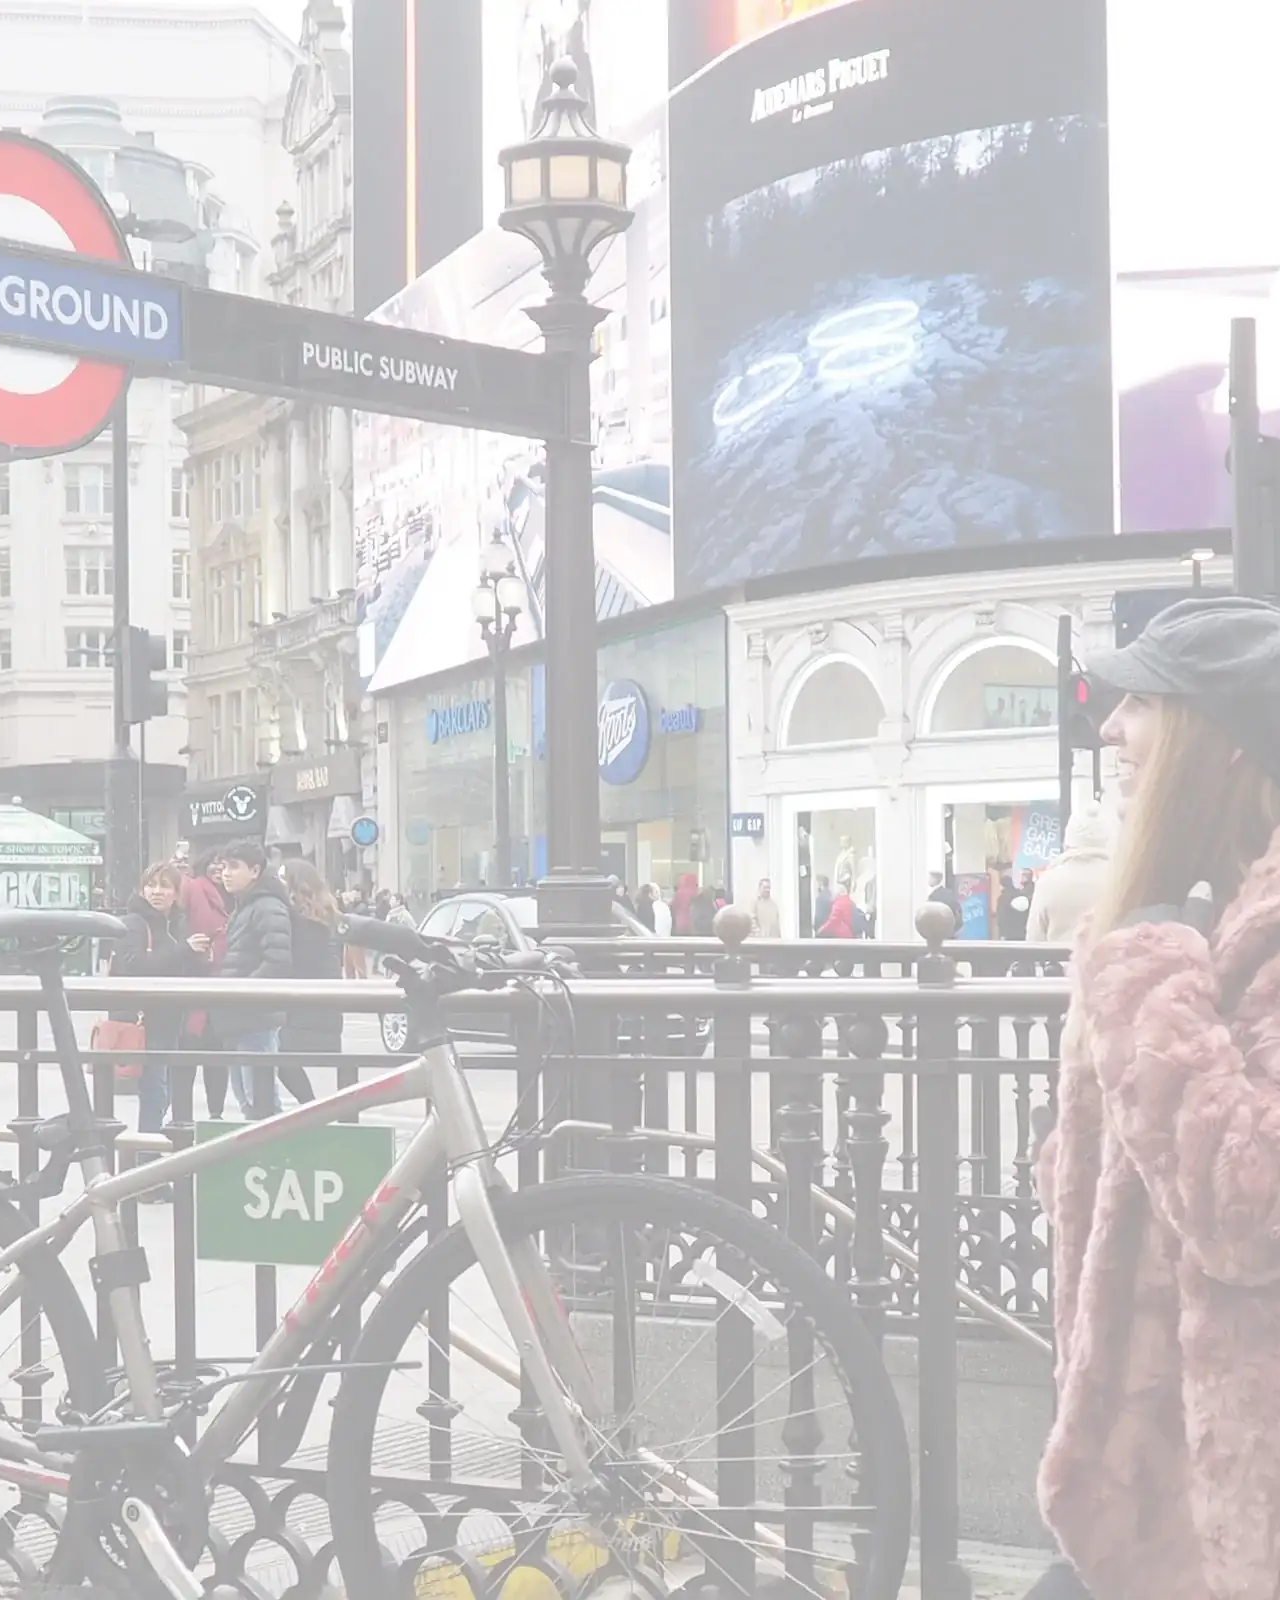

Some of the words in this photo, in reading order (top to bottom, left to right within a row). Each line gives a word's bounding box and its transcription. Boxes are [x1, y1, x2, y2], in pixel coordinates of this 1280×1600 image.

[828, 48, 891, 93] PIGUET
[302, 341, 374, 378] PUBLIC
[378, 354, 459, 392] SUBWAY
[438, 699, 492, 738] BARCLAYS
[598, 695, 637, 766] Boots
[659, 703, 700, 733] beauty
[1029, 812, 1061, 831] GRE
[242, 1166, 345, 1222] SAP
